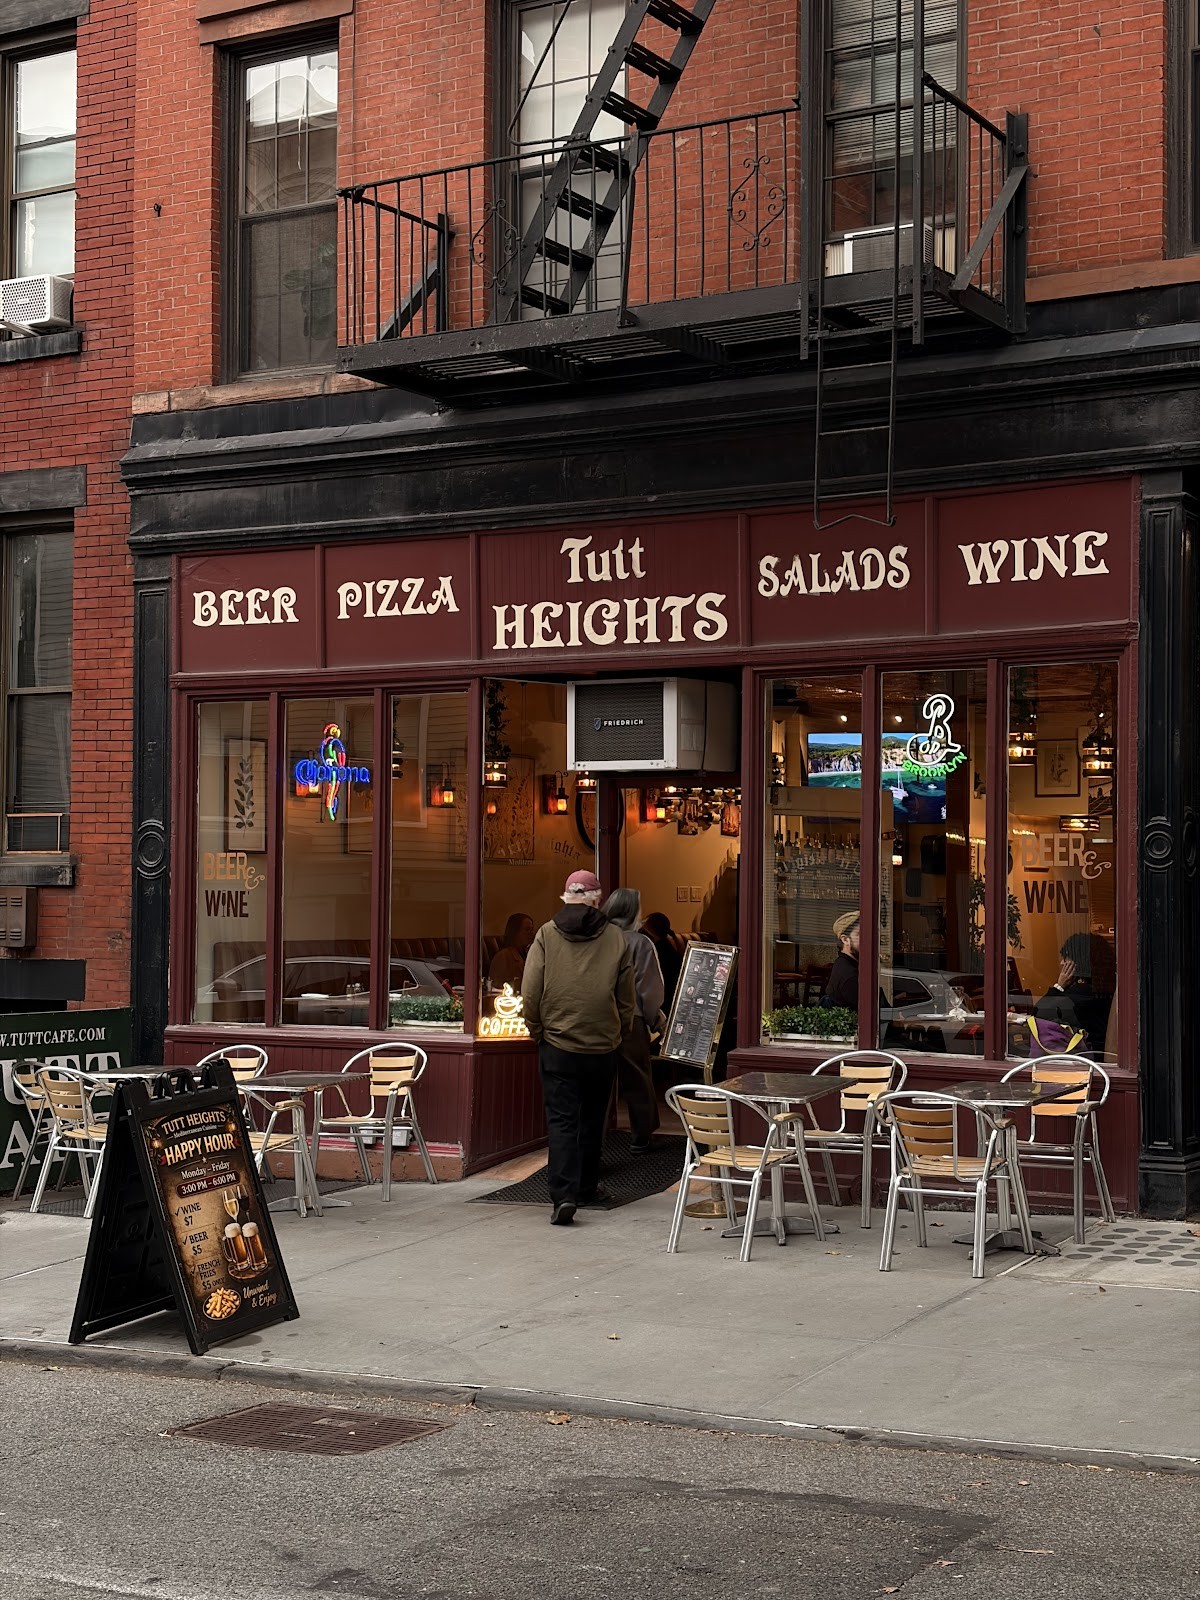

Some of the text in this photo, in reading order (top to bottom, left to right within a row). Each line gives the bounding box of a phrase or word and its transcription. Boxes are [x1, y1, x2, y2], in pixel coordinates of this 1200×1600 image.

[560, 535, 646, 584] Tutt
[958, 530, 1110, 585] WINE
[757, 545, 911, 598] SALADS
[193, 586, 299, 627] BEER
[336, 576, 459, 620] PIZZA
[492, 592, 729, 650] HEIGHTS
[294, 759, 370, 787] Corona
[902, 752, 968, 777] BROOKLYN
[1022, 833, 1085, 867] BEER
[204, 853, 248, 880] BEER
[162, 1111, 226, 1135] TUTT HEIGHTS
[164, 1133, 236, 1166] HAPPY HOUR
[181, 1167, 206, 1180] Monday
[211, 1161, 230, 1171] Friday
[181, 1183, 197, 1194] 3:00
[197, 1180, 208, 1190] PM
[212, 1176, 227, 1186] 6:00
[226, 1173, 236, 1182] PM
[181, 1202, 201, 1215] WINE
[183, 1216, 193, 1226] $7
[189, 1231, 209, 1244] BEER
[192, 1245, 203, 1256] $5
[197, 1259, 221, 1272] FRENCH
[200, 1269, 217, 1280] FRIES
[202, 1280, 212, 1290] $5
[243, 1280, 269, 1299] Unwind
[251, 1292, 278, 1308] & Enjoy
